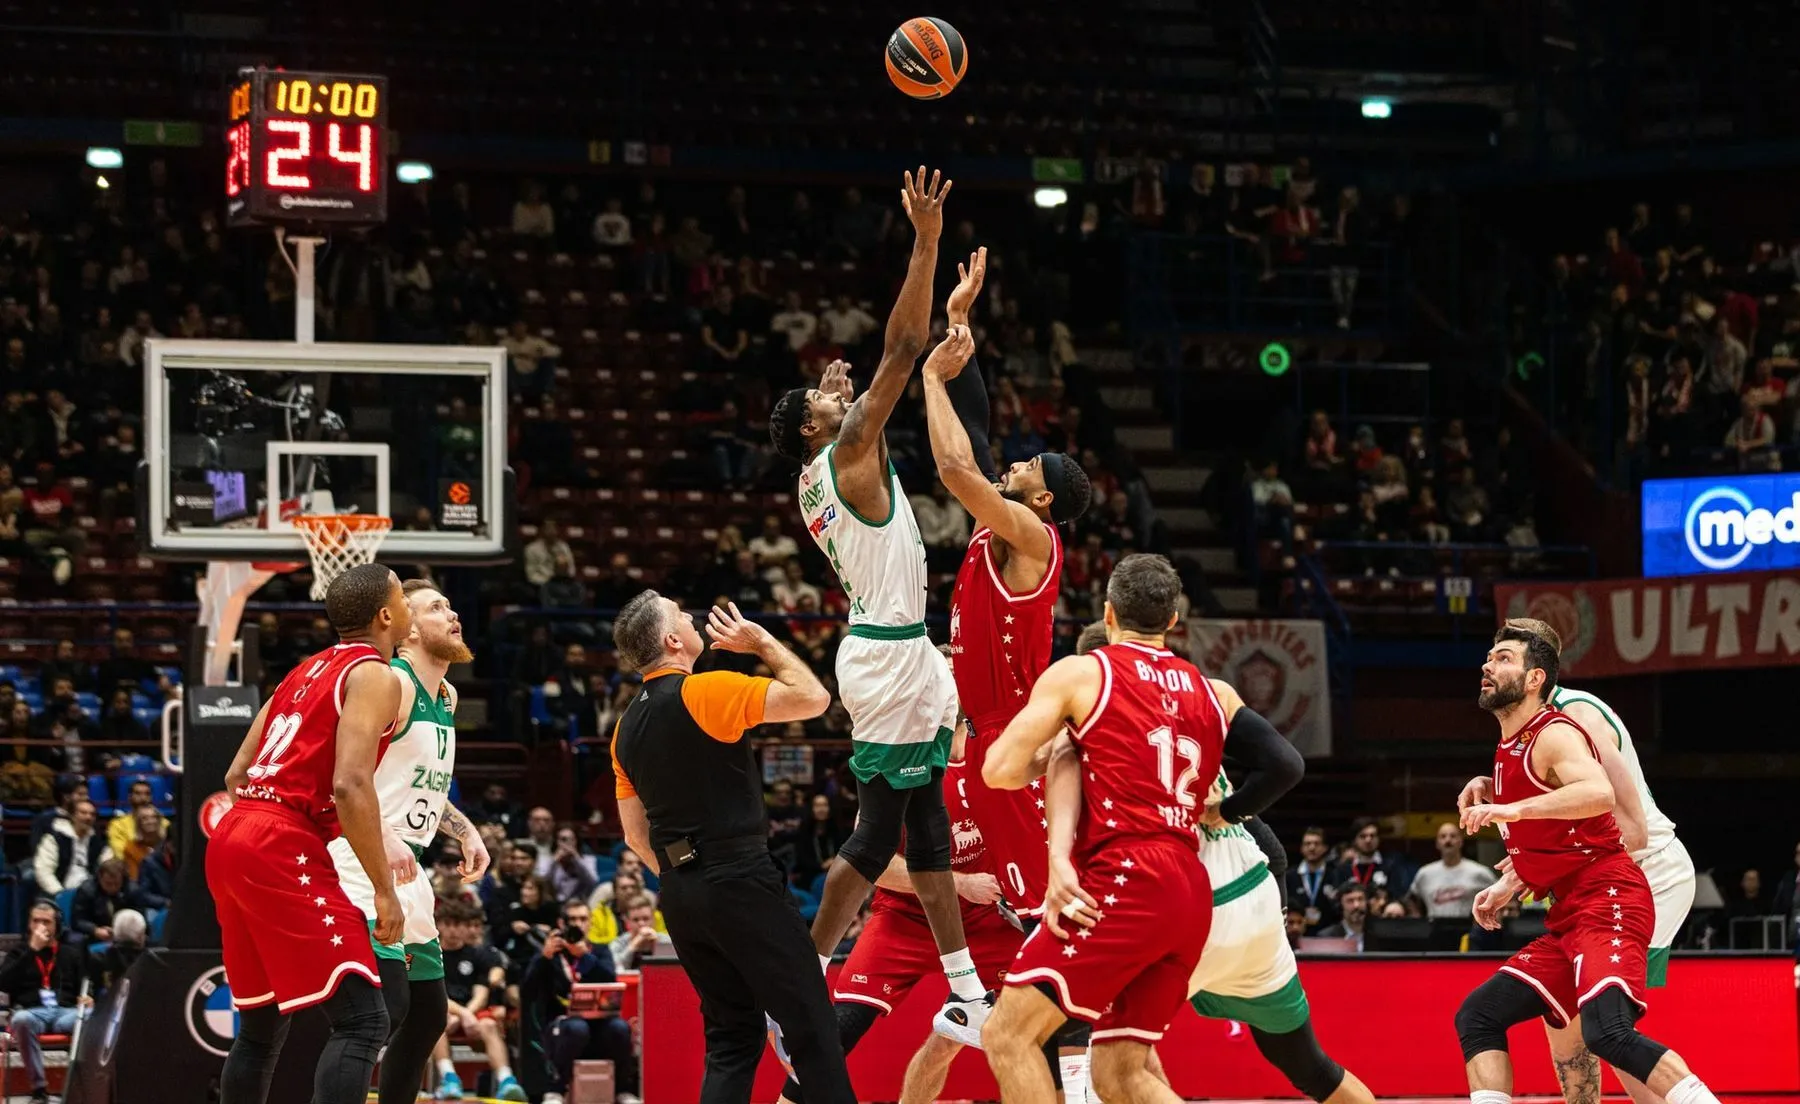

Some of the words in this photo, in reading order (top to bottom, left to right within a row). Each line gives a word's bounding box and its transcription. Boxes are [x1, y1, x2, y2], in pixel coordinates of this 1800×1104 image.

[276, 80, 377, 118] 10:00
[267, 120, 371, 191] 24
[246, 712, 303, 780] 22
[1147, 724, 1202, 810] 12
